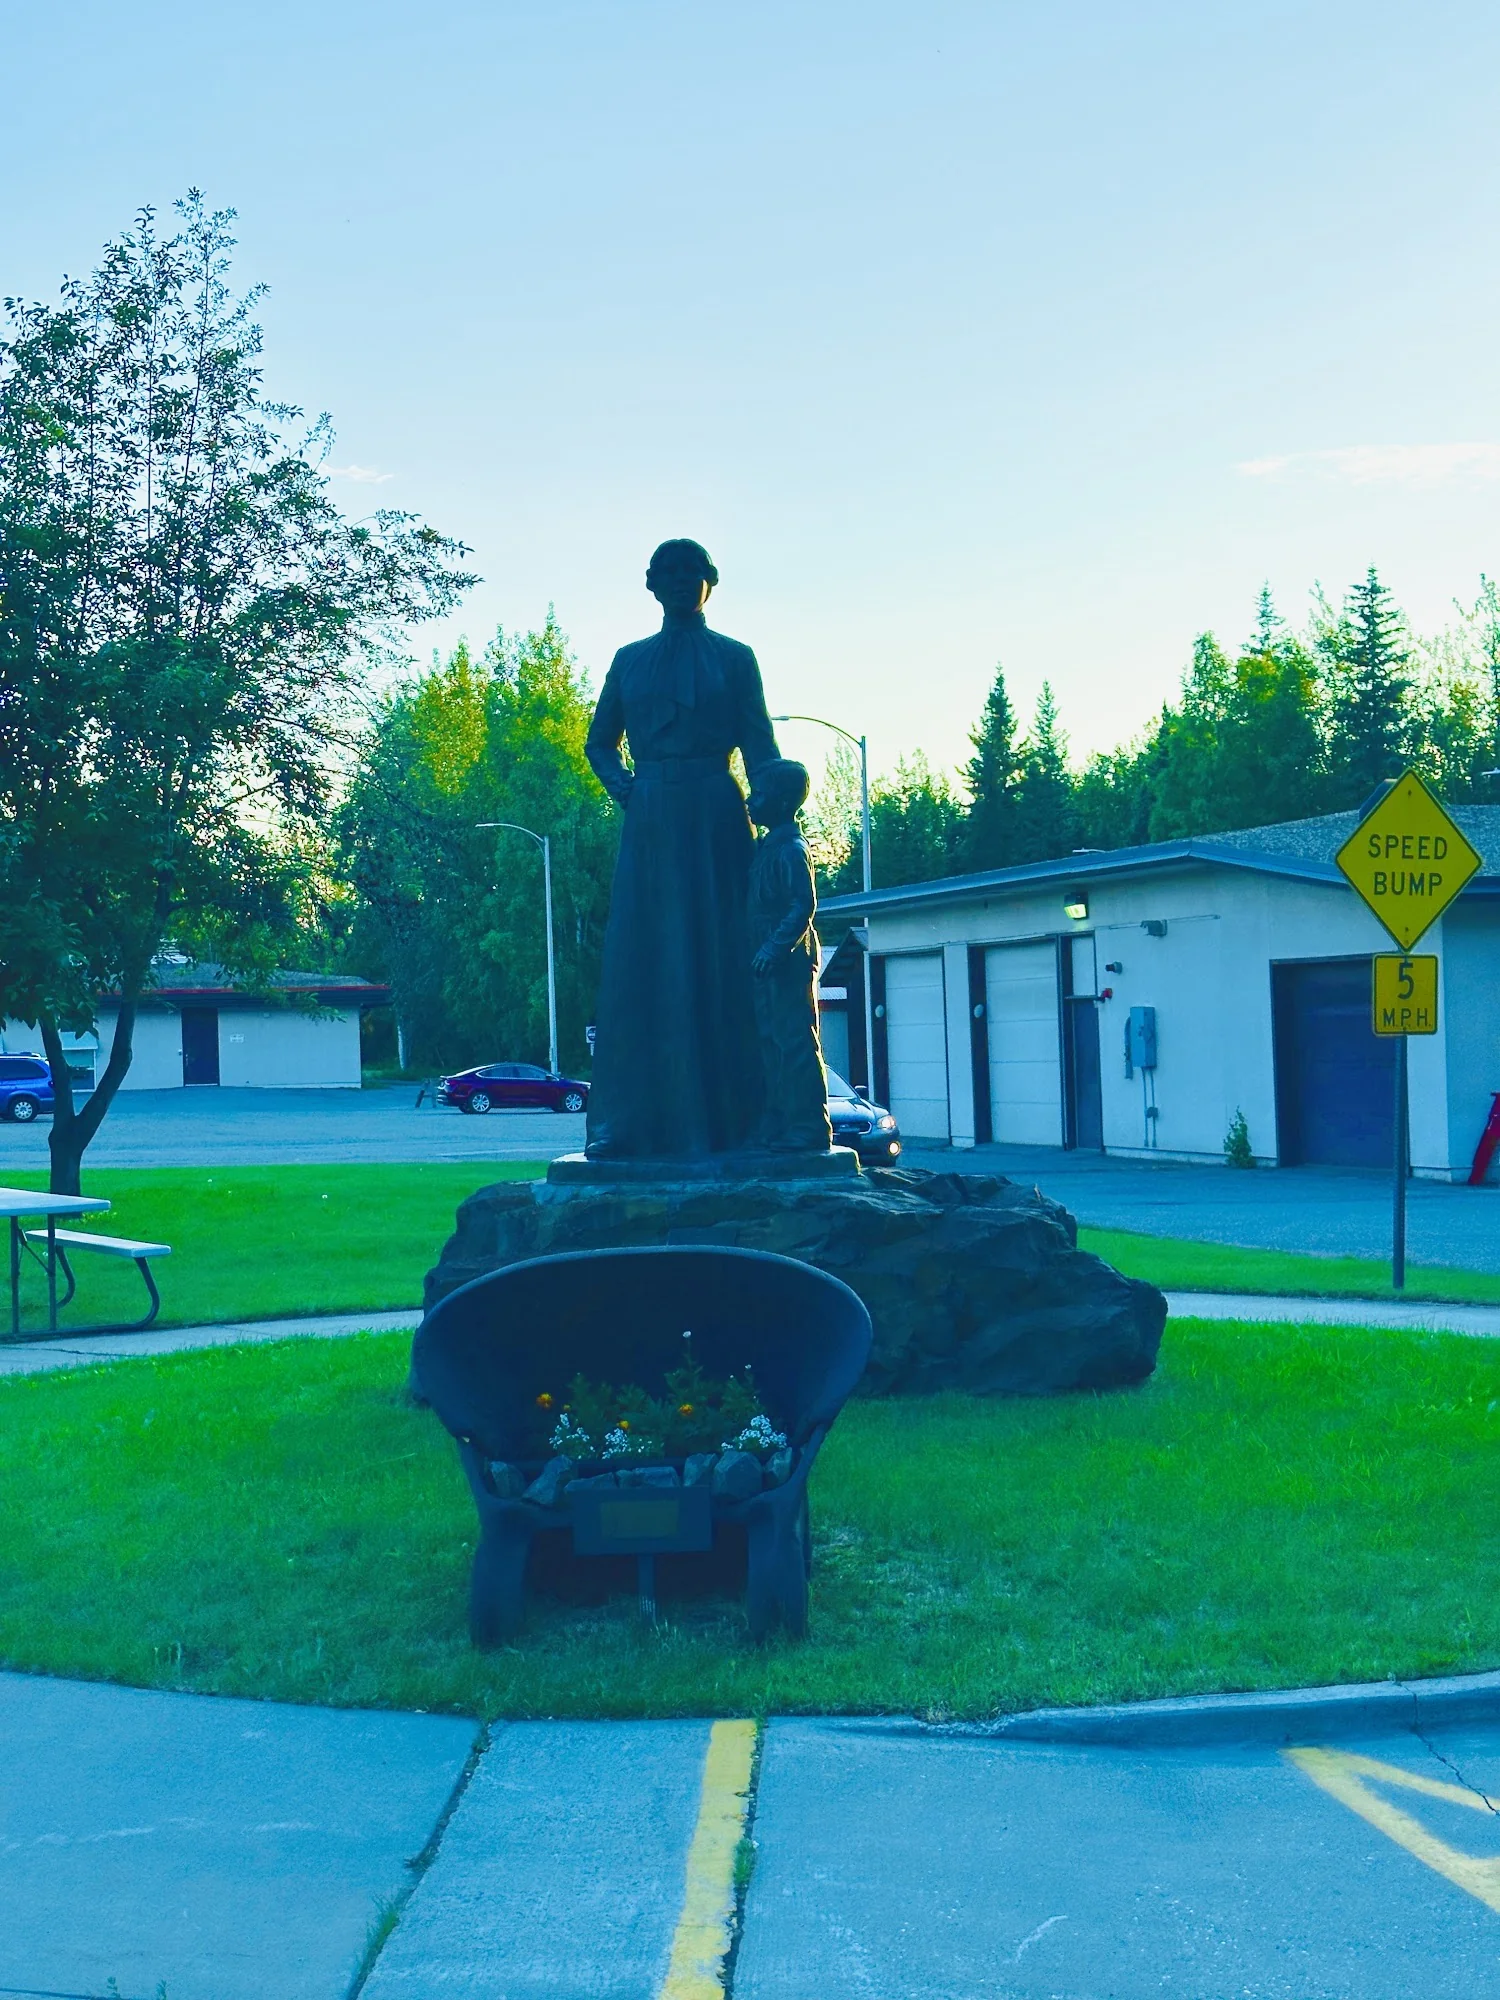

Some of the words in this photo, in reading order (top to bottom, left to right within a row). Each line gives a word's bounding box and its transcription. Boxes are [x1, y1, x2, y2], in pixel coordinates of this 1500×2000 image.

[1368, 833, 1448, 860] SPEED
[1373, 871, 1443, 897] BUMP
[1397, 962, 1414, 1000] 5
